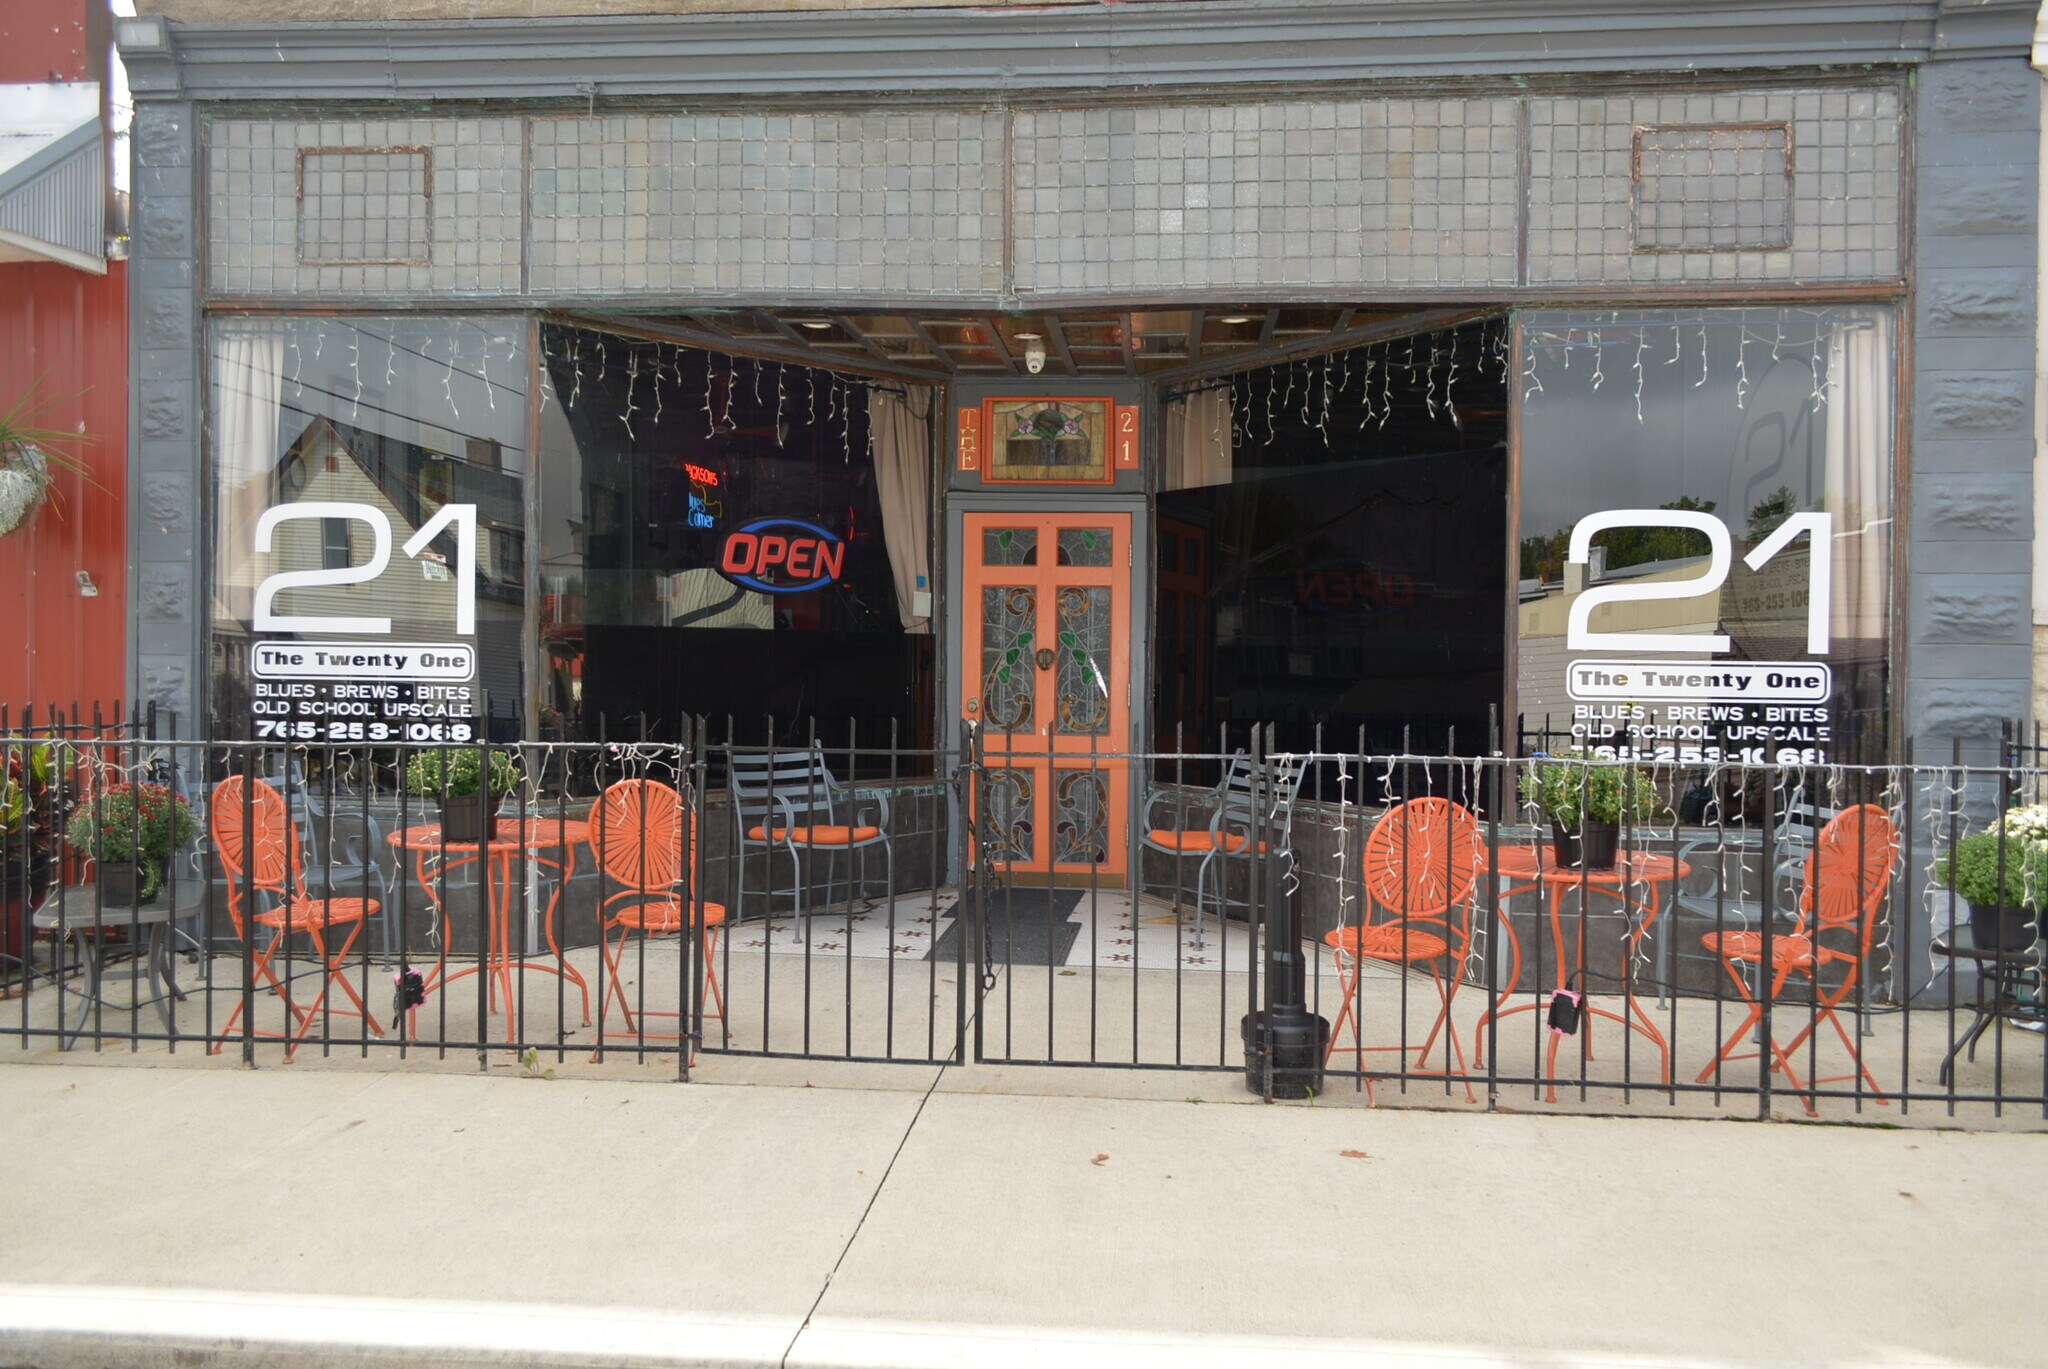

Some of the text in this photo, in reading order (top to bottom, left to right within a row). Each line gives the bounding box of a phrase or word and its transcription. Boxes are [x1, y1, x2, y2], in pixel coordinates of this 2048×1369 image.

[960, 408, 977, 470] THE
[722, 533, 845, 580] OPEN
[253, 502, 477, 635] 21
[1567, 509, 1832, 654] 21
[261, 651, 466, 670] The Twenty One
[1578, 671, 1820, 691] The Twenty One
[255, 684, 470, 700] BLUES BREWS BITES
[253, 701, 472, 718] OLD SCHOOL UPSCALE
[1574, 704, 1828, 722] BLUES BREWS BITES
[255, 720, 472, 742] 765-253-068
[1626, 725, 1716, 740] SCHOOL
[1727, 726, 1830, 742] UPSCALE
